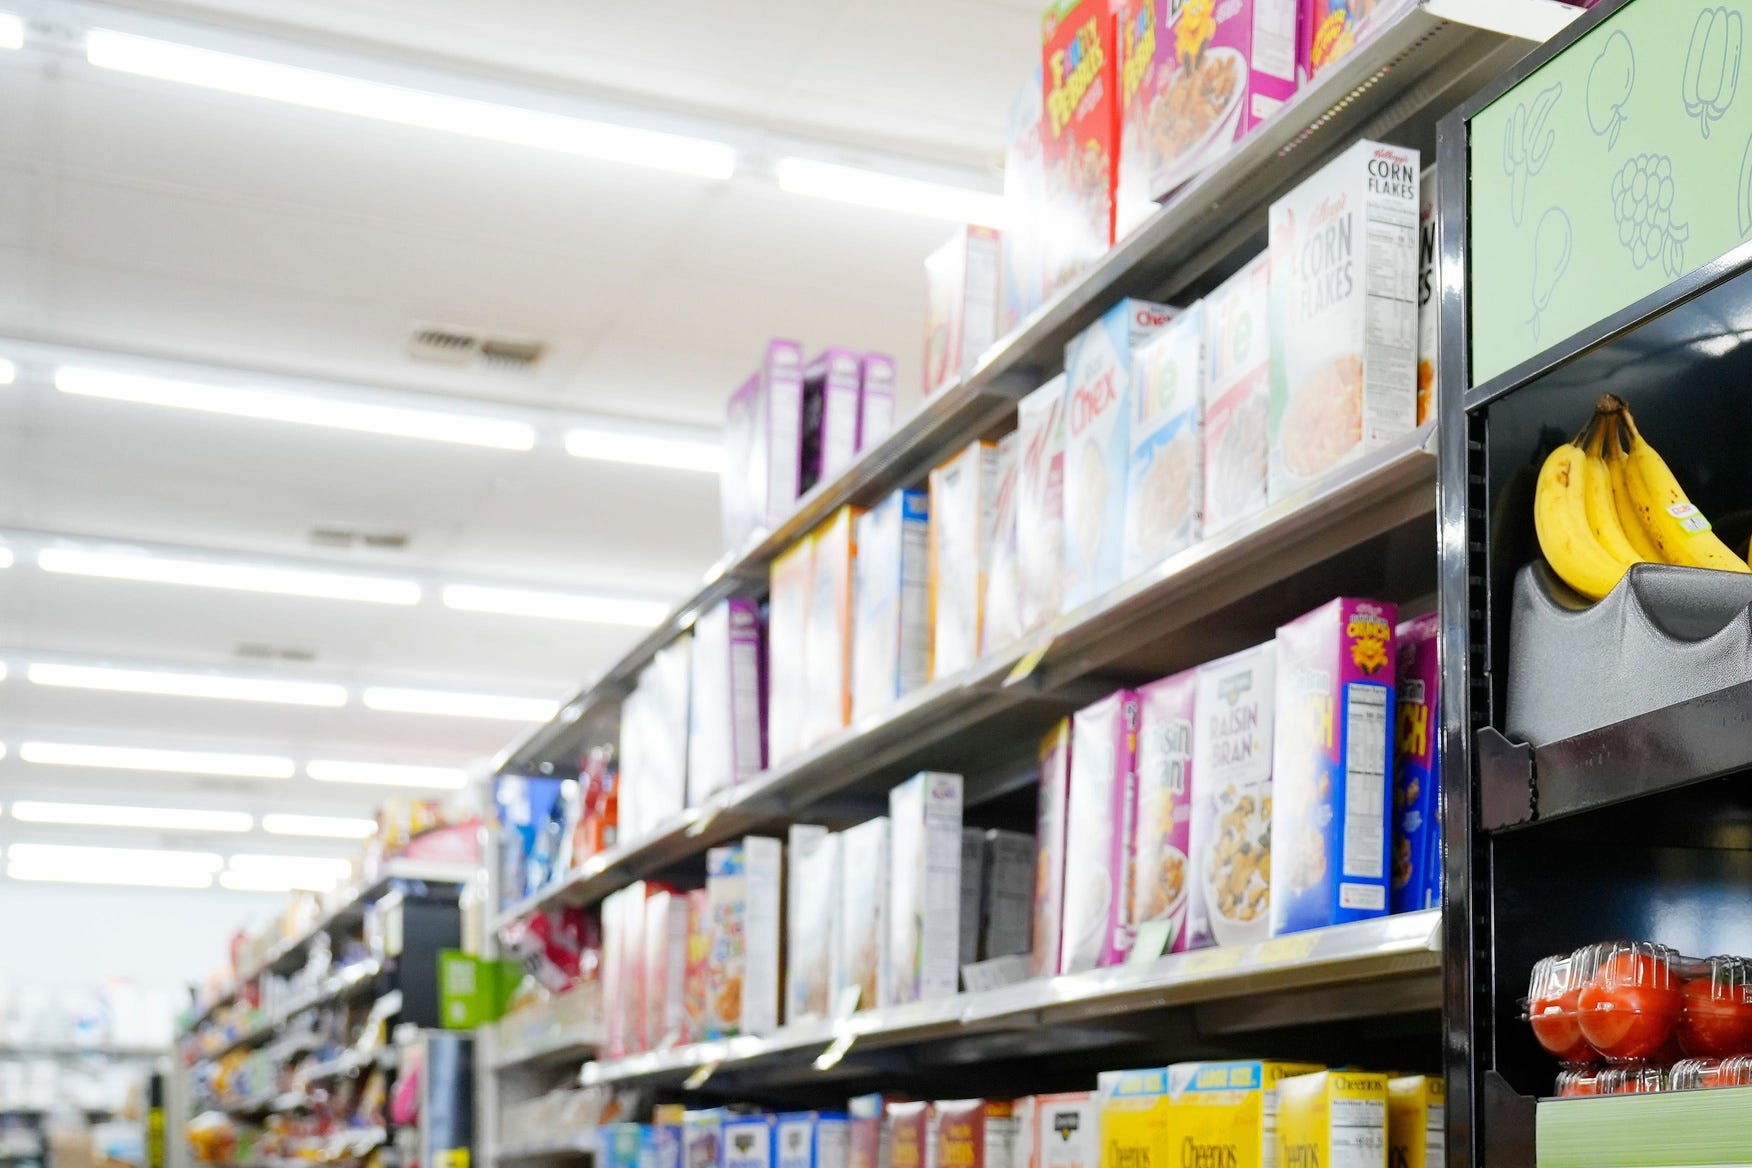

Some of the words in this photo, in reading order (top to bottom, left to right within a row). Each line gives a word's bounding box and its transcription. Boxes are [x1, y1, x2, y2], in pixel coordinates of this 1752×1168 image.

[1367, 159, 1413, 183] CORN
[1368, 177, 1415, 200] FLAKES
[1301, 212, 1352, 283] CORN
[1210, 703, 1258, 741] RAISIN
[1211, 739, 1252, 770] BRAN
[1335, 1077, 1383, 1092] Cheerios
